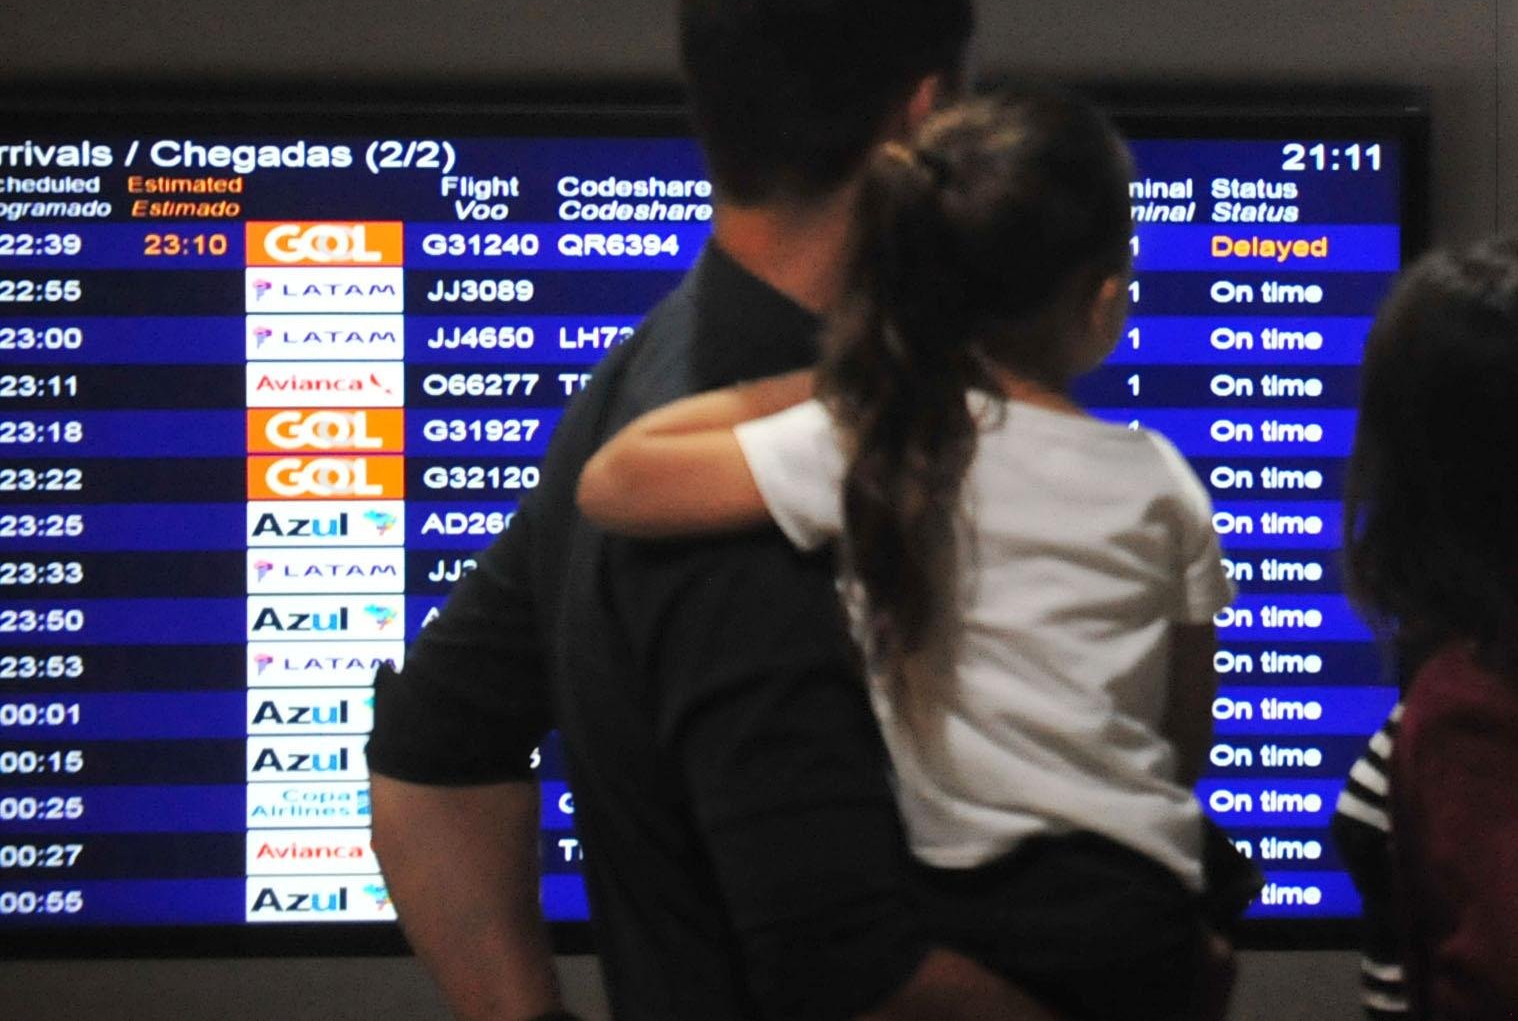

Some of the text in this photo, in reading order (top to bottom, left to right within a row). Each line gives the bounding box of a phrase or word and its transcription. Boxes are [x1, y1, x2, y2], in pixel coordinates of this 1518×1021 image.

[125, 141, 139, 166] /
[151, 140, 352, 173] Chegadas
[366, 141, 455, 174] (2/2)
[1282, 143, 1380, 170] 21:11
[128, 176, 243, 193] Estimated
[441, 175, 520, 201] Flight
[558, 177, 712, 197] Codeshare
[1212, 178, 1298, 199] Status
[132, 200, 240, 217] Estimado
[144, 234, 227, 255] 23:10
[264, 224, 383, 263] GOL
[422, 234, 539, 255] G31240
[558, 234, 679, 256] QR6394
[1211, 235, 1328, 262] Delayed
[428, 280, 534, 301] JJ3089
[1211, 281, 1323, 303] On time
[428, 327, 534, 348] JJ4650
[256, 374, 363, 391] Avianca
[423, 419, 540, 441] G31927
[251, 887, 348, 912] Azul
